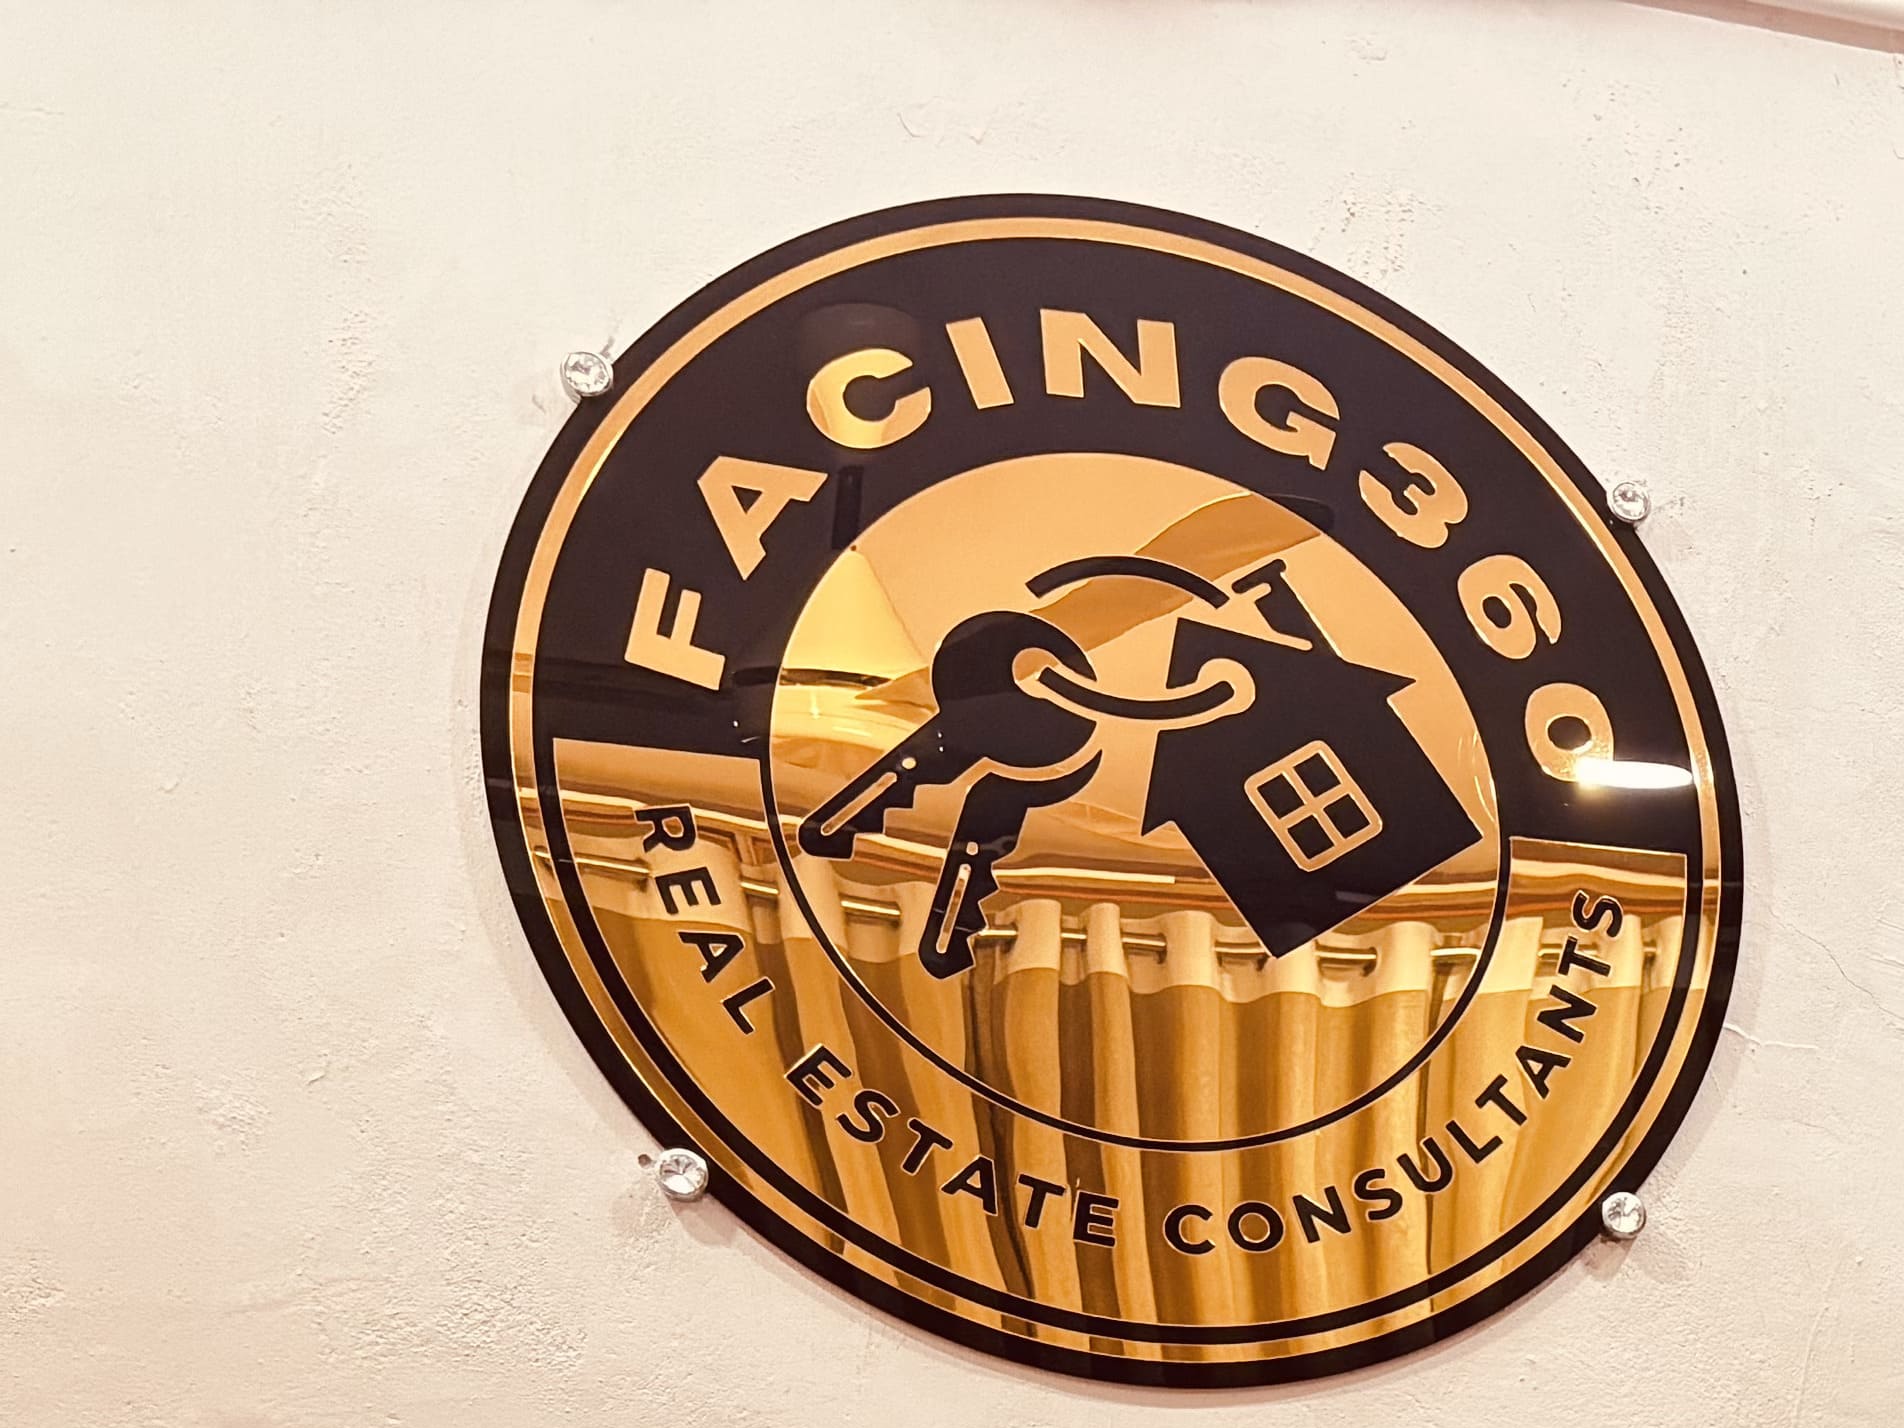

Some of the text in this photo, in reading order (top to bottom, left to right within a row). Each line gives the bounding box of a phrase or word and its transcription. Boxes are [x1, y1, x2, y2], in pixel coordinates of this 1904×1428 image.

[622, 308, 1615, 783] FACING360
[632, 804, 1625, 1257] REAL ESTATE CONSULTANTS
